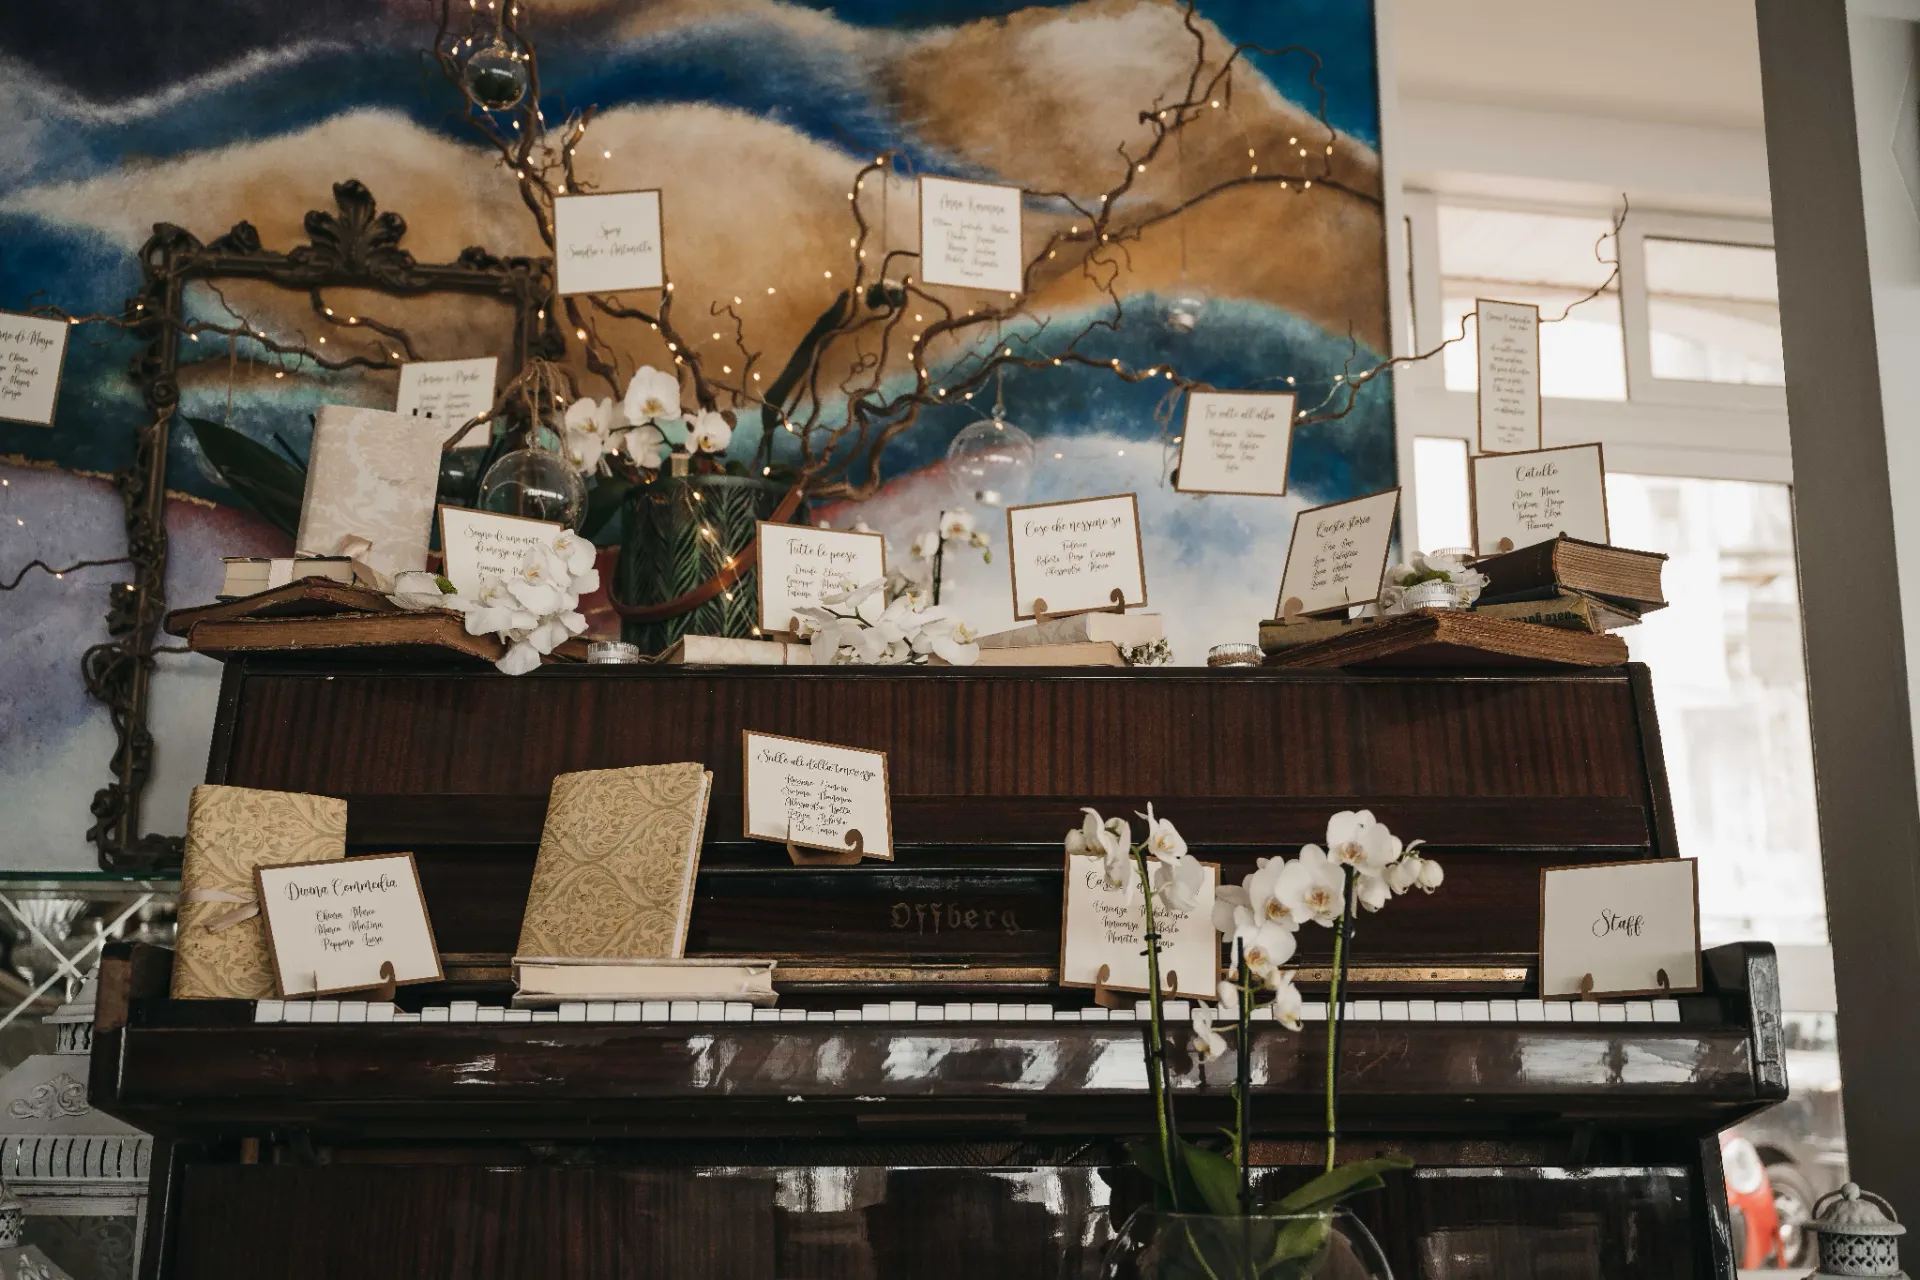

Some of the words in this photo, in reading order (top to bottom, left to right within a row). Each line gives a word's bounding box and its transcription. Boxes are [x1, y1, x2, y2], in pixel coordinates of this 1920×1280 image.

[1515, 462, 1560, 482] Catullo
[1024, 520, 1049, 537] Cose
[1051, 517, 1067, 533] che
[1069, 518, 1108, 532] nessuno
[786, 538, 814, 556] Tutte
[817, 544, 828, 557] le
[757, 748, 788, 764] Sulle
[790, 755, 804, 767] ali
[284, 880, 329, 901] Divina
[331, 873, 398, 897] Commedia
[315, 909, 344, 923] Chiara
[1592, 908, 1645, 938] Staff
